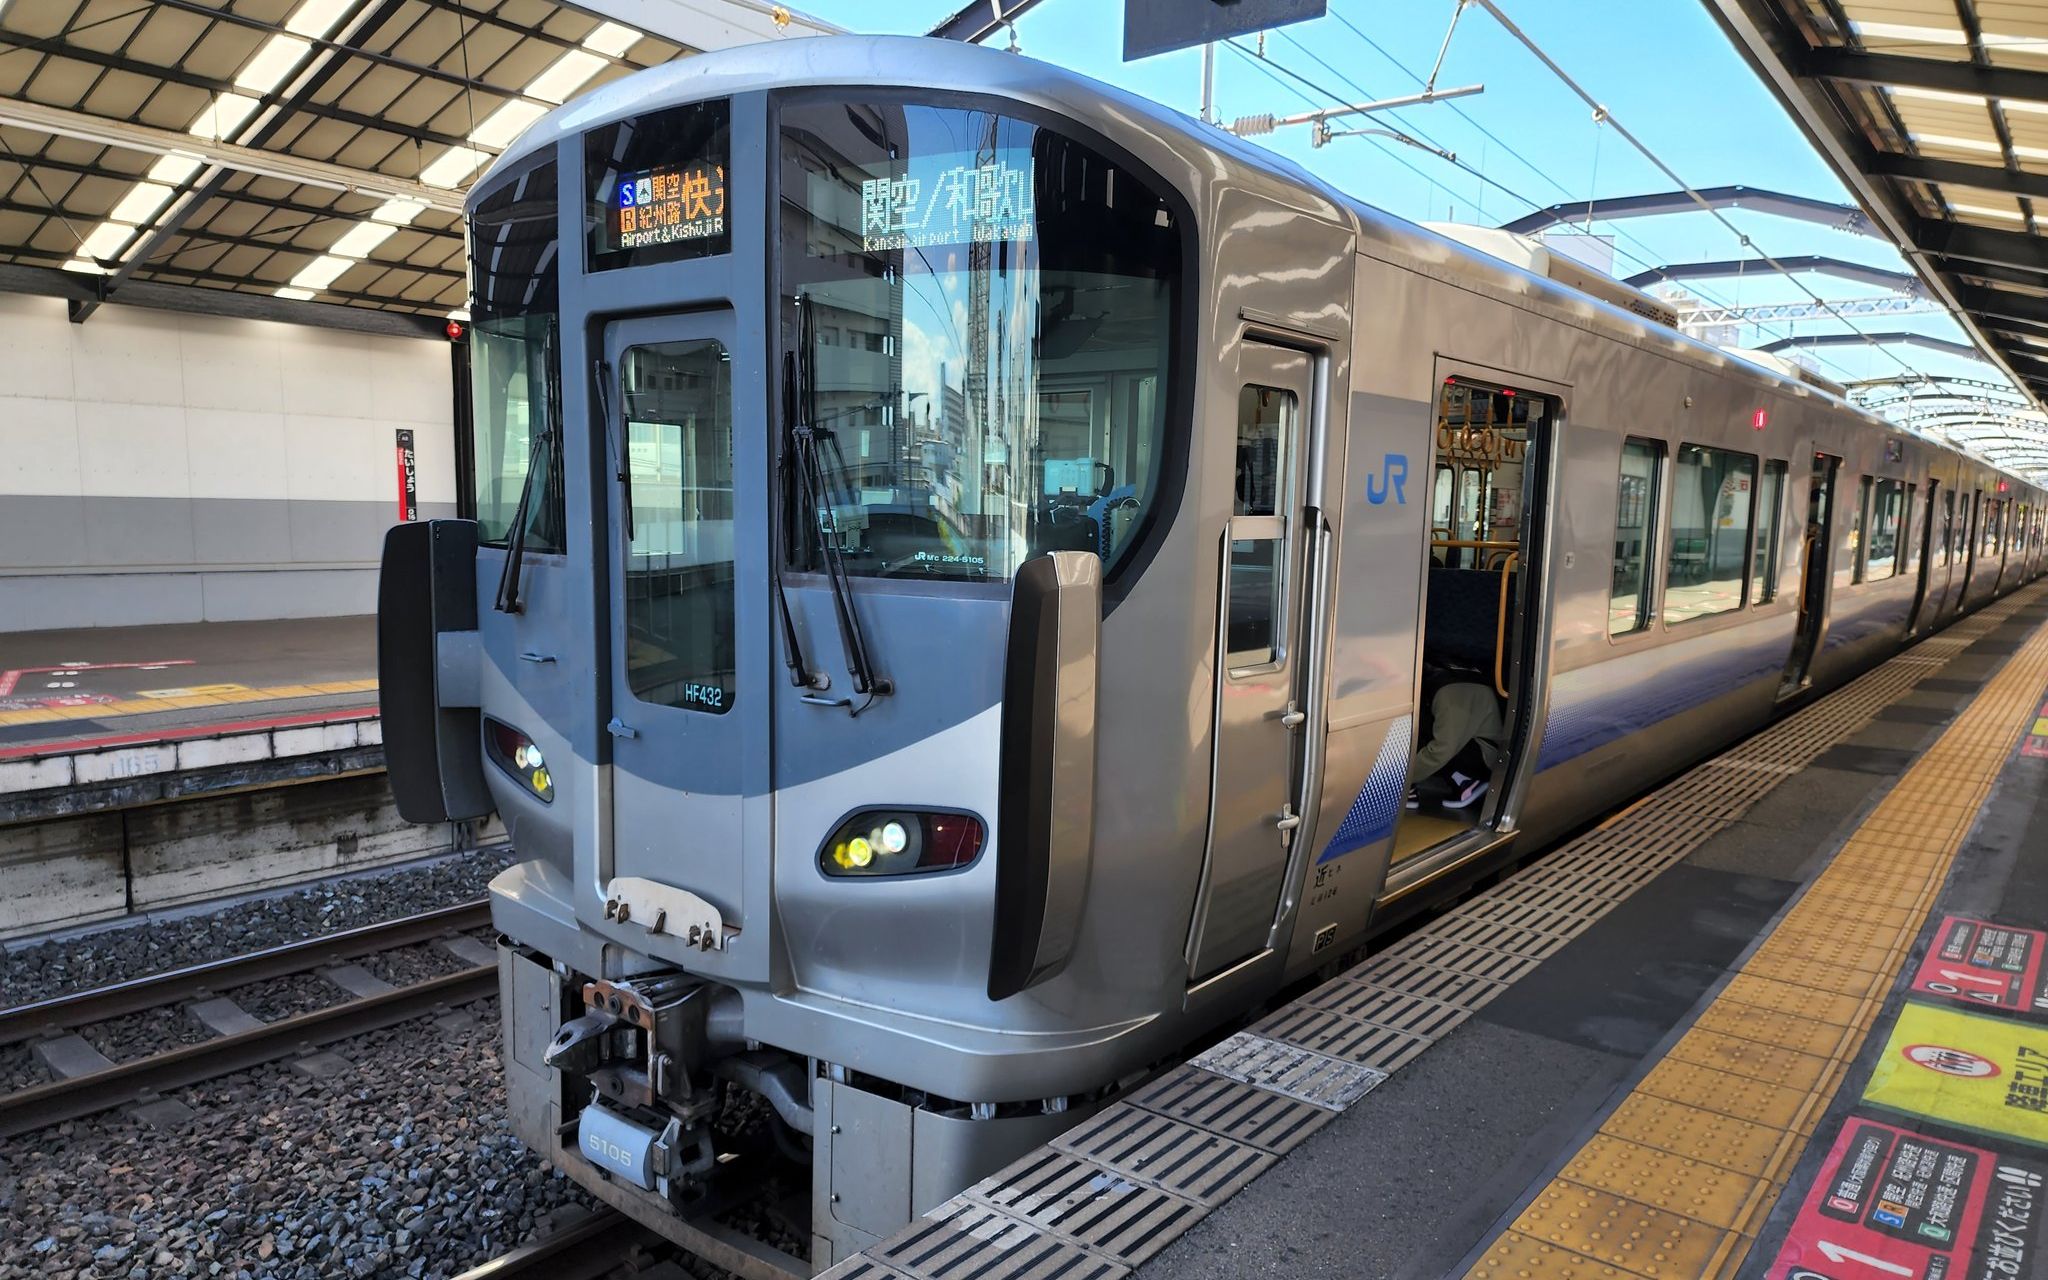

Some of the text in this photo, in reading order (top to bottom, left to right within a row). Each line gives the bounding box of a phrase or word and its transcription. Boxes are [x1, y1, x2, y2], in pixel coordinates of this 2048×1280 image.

[622, 173, 680, 205] S 関空
[640, 201, 680, 229] 紀州路
[404, 449, 415, 493] たいしょう
[1367, 454, 1408, 505] JR
[914, 551, 926, 561] JR
[685, 683, 722, 707] HF432
[589, 1134, 632, 1167] 5105
[1817, 1240, 1914, 1278] 1
